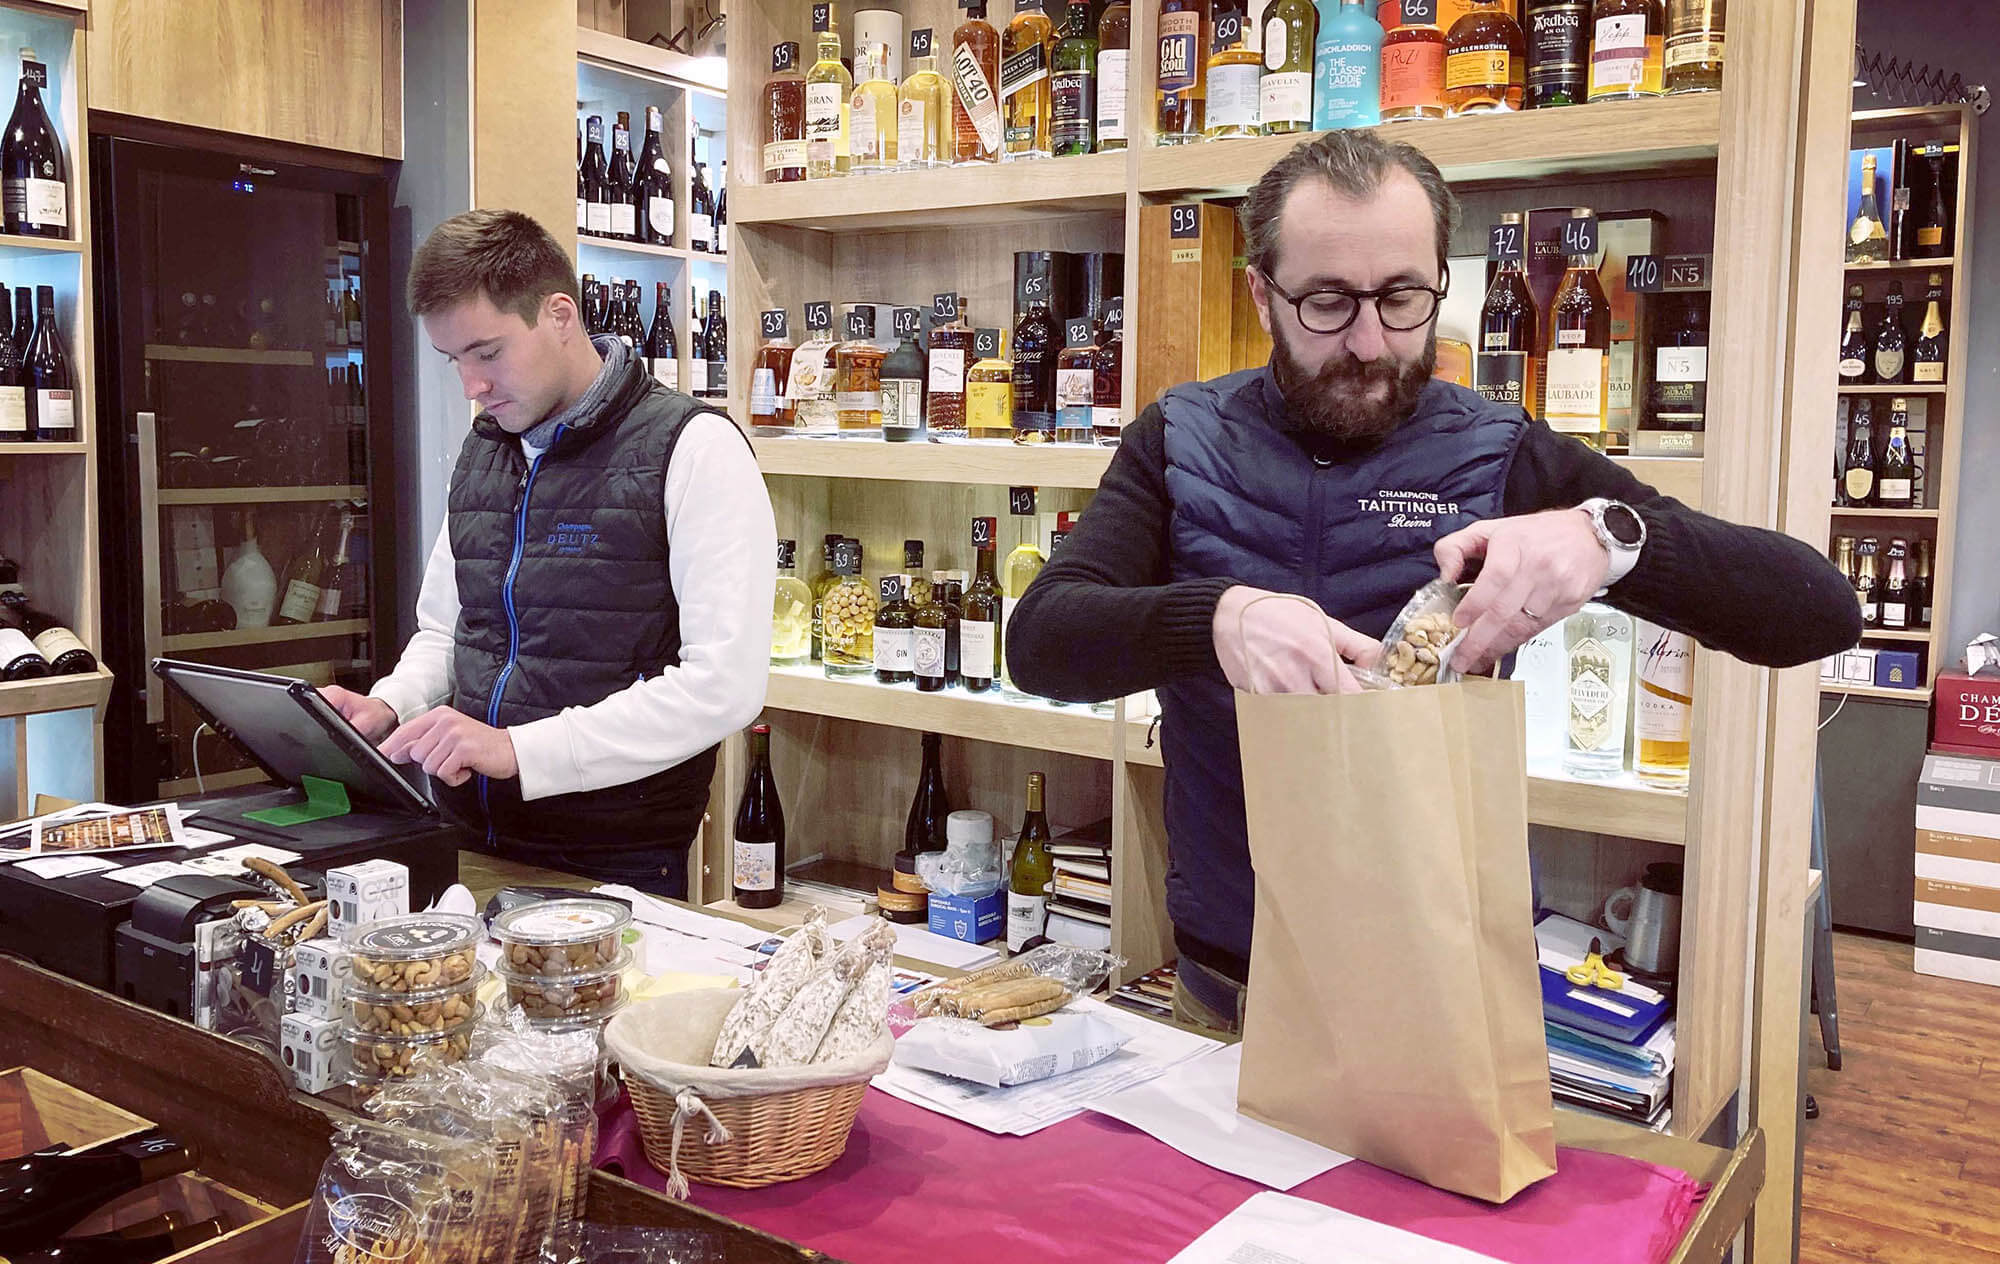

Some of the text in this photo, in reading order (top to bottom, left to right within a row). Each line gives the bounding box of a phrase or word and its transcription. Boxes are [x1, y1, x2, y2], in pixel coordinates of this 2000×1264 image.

[1405, 0, 1429, 16] 66
[1218, 18, 1238, 38] 60
[913, 35, 928, 50] 45
[1161, 38, 1187, 61] Old
[1318, 44, 1372, 56] CHLADDICH
[1460, 44, 1507, 52] GLENROTHES
[1160, 58, 1186, 74] Scout
[1330, 57, 1346, 67] THE
[1491, 60, 1505, 71] 12
[954, 47, 978, 79] LOT
[970, 79, 989, 101] 40
[1329, 65, 1366, 76] CLASSIC
[1061, 96, 1067, 105] 5
[1173, 208, 1196, 232] 99
[1495, 228, 1518, 255] 72
[1566, 222, 1590, 250] 46
[1535, 246, 1561, 254] LAUB
[1629, 256, 1657, 288] 110
[586, 283, 599, 295] 16
[1025, 277, 1043, 294] 65
[934, 296, 957, 317] 53
[1887, 294, 1903, 305] 195
[763, 313, 784, 333] 38
[808, 304, 828, 327] 45
[895, 312, 912, 334] 48
[850, 317, 866, 336] 47
[1070, 325, 1088, 342] 83
[976, 335, 993, 351] 63
[1480, 391, 1520, 401] UBADE
[1855, 413, 1870, 425] 45
[1891, 412, 1907, 425] 47
[1011, 492, 1031, 513] 49
[1378, 490, 1438, 501] CHAMPAGNE
[1357, 499, 1460, 514] TAITTINGER
[1387, 513, 1432, 527] Reims
[547, 533, 599, 545] DEUTZ
[973, 520, 987, 542] 32
[881, 580, 898, 596] 50
[896, 648, 908, 658] GIN
[250, 951, 263, 986] 4
